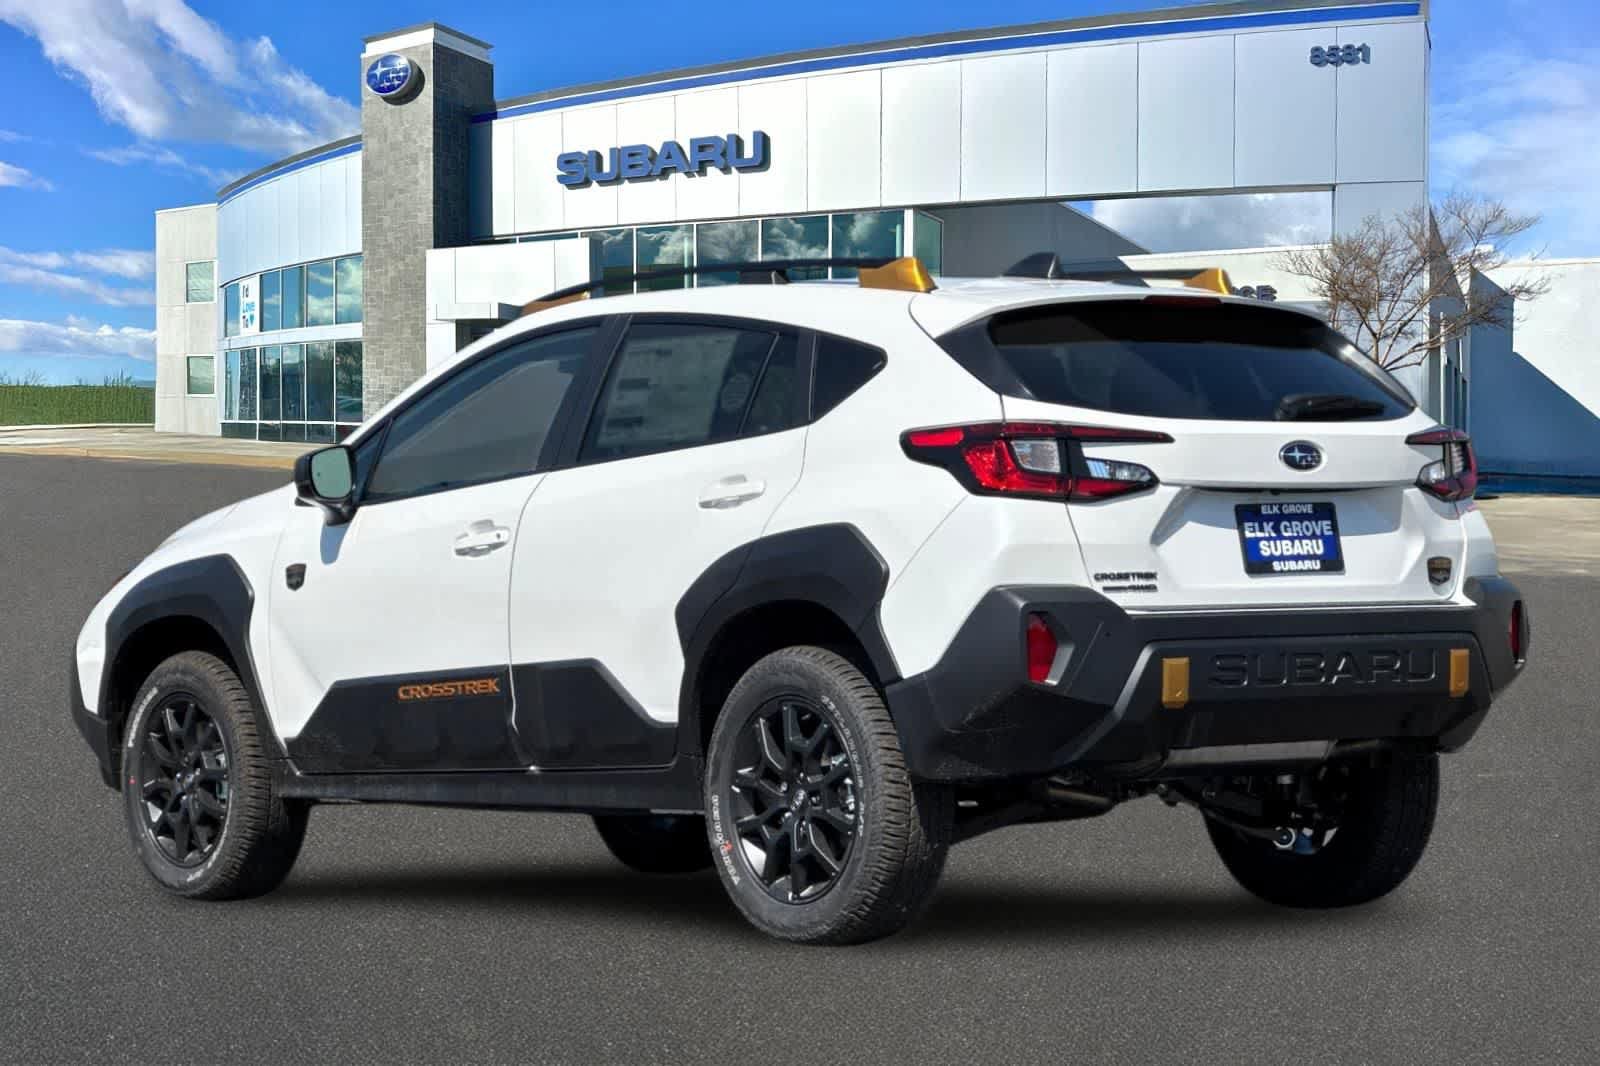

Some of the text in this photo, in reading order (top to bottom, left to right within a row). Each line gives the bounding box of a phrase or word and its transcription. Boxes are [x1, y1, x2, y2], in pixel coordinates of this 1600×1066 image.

[556, 130, 771, 190] SUBARU
[1261, 504, 1313, 514] ELK GROVE
[1244, 520, 1333, 538] ELK GROVE
[1259, 539, 1324, 556] SUBARU
[1272, 560, 1321, 571] SUBARU
[1208, 649, 1437, 688] SUBARU
[398, 678, 500, 700] CROSSTREK
